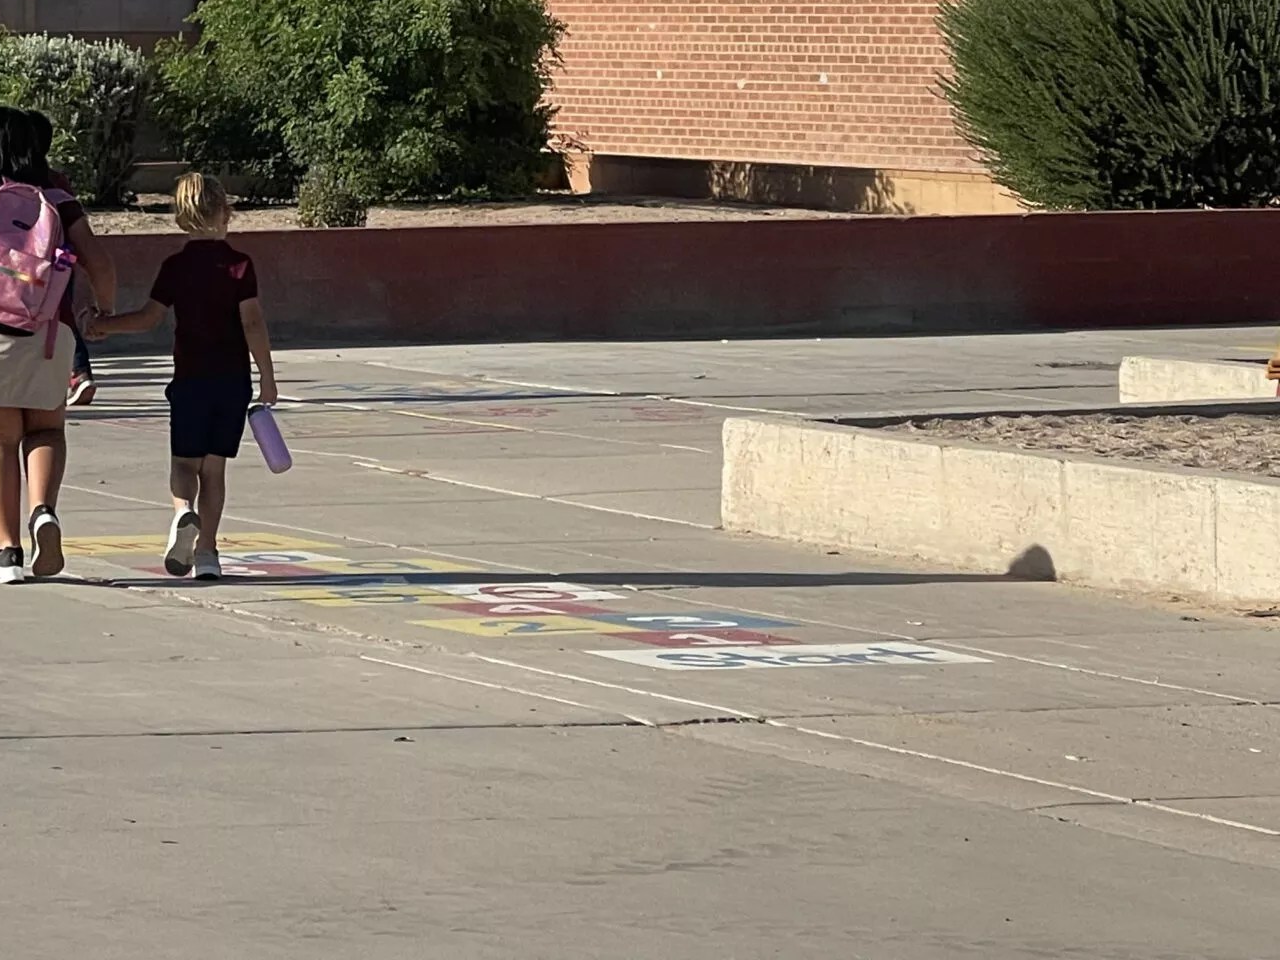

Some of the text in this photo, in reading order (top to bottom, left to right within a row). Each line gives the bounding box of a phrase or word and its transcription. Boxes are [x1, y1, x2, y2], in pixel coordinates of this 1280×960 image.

[477, 585, 578, 600] 6
[479, 620, 596, 633] 2
[626, 616, 740, 628] 3
[669, 633, 763, 645] 1
[656, 647, 944, 668] Start
